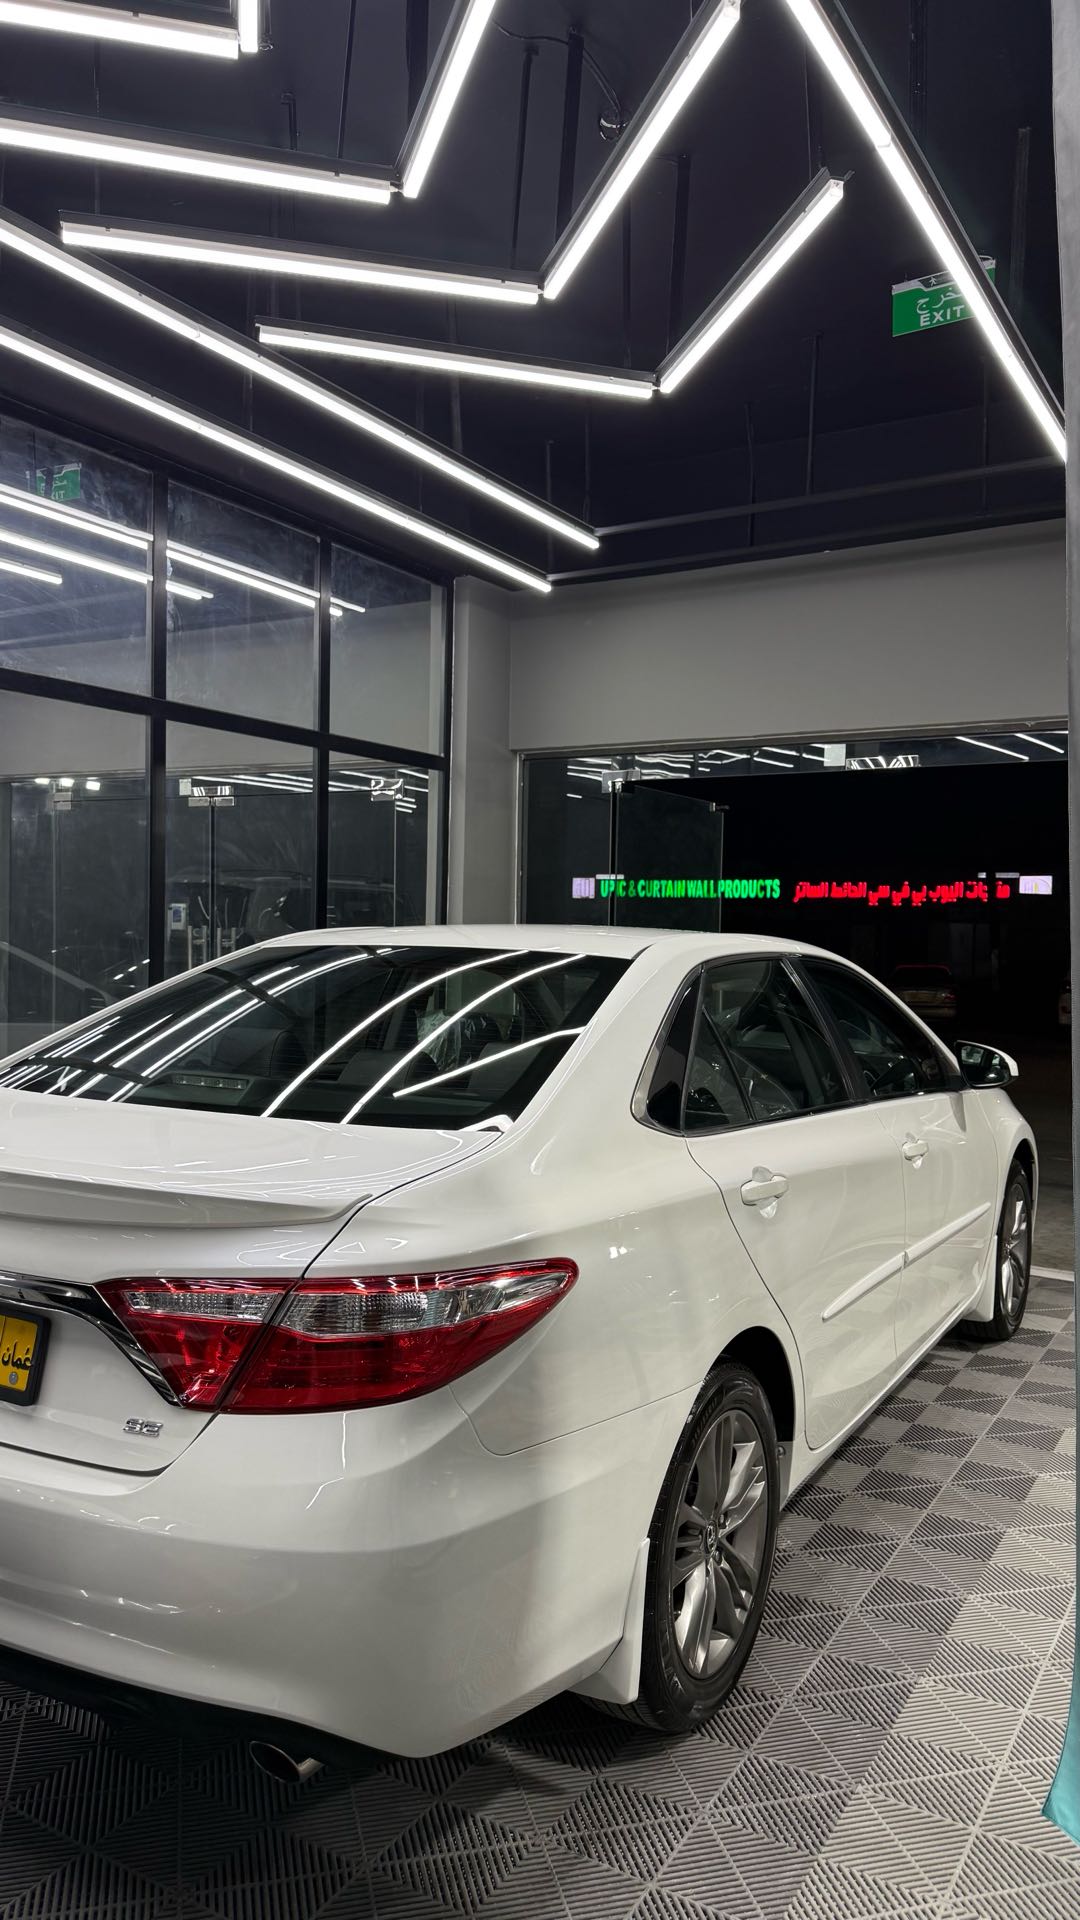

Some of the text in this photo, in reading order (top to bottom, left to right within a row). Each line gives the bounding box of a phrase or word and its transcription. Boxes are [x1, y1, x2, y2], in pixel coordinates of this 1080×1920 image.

[916, 287, 963, 314] خرج
[919, 304, 965, 327] EXIT
[600, 879, 627, 898] UPC
[628, 879, 637, 897] &
[637, 879, 686, 898] CURTAIN
[686, 879, 717, 898] WALL
[717, 878, 781, 899] PRODUCTS
[123, 1418, 164, 1437] SE
